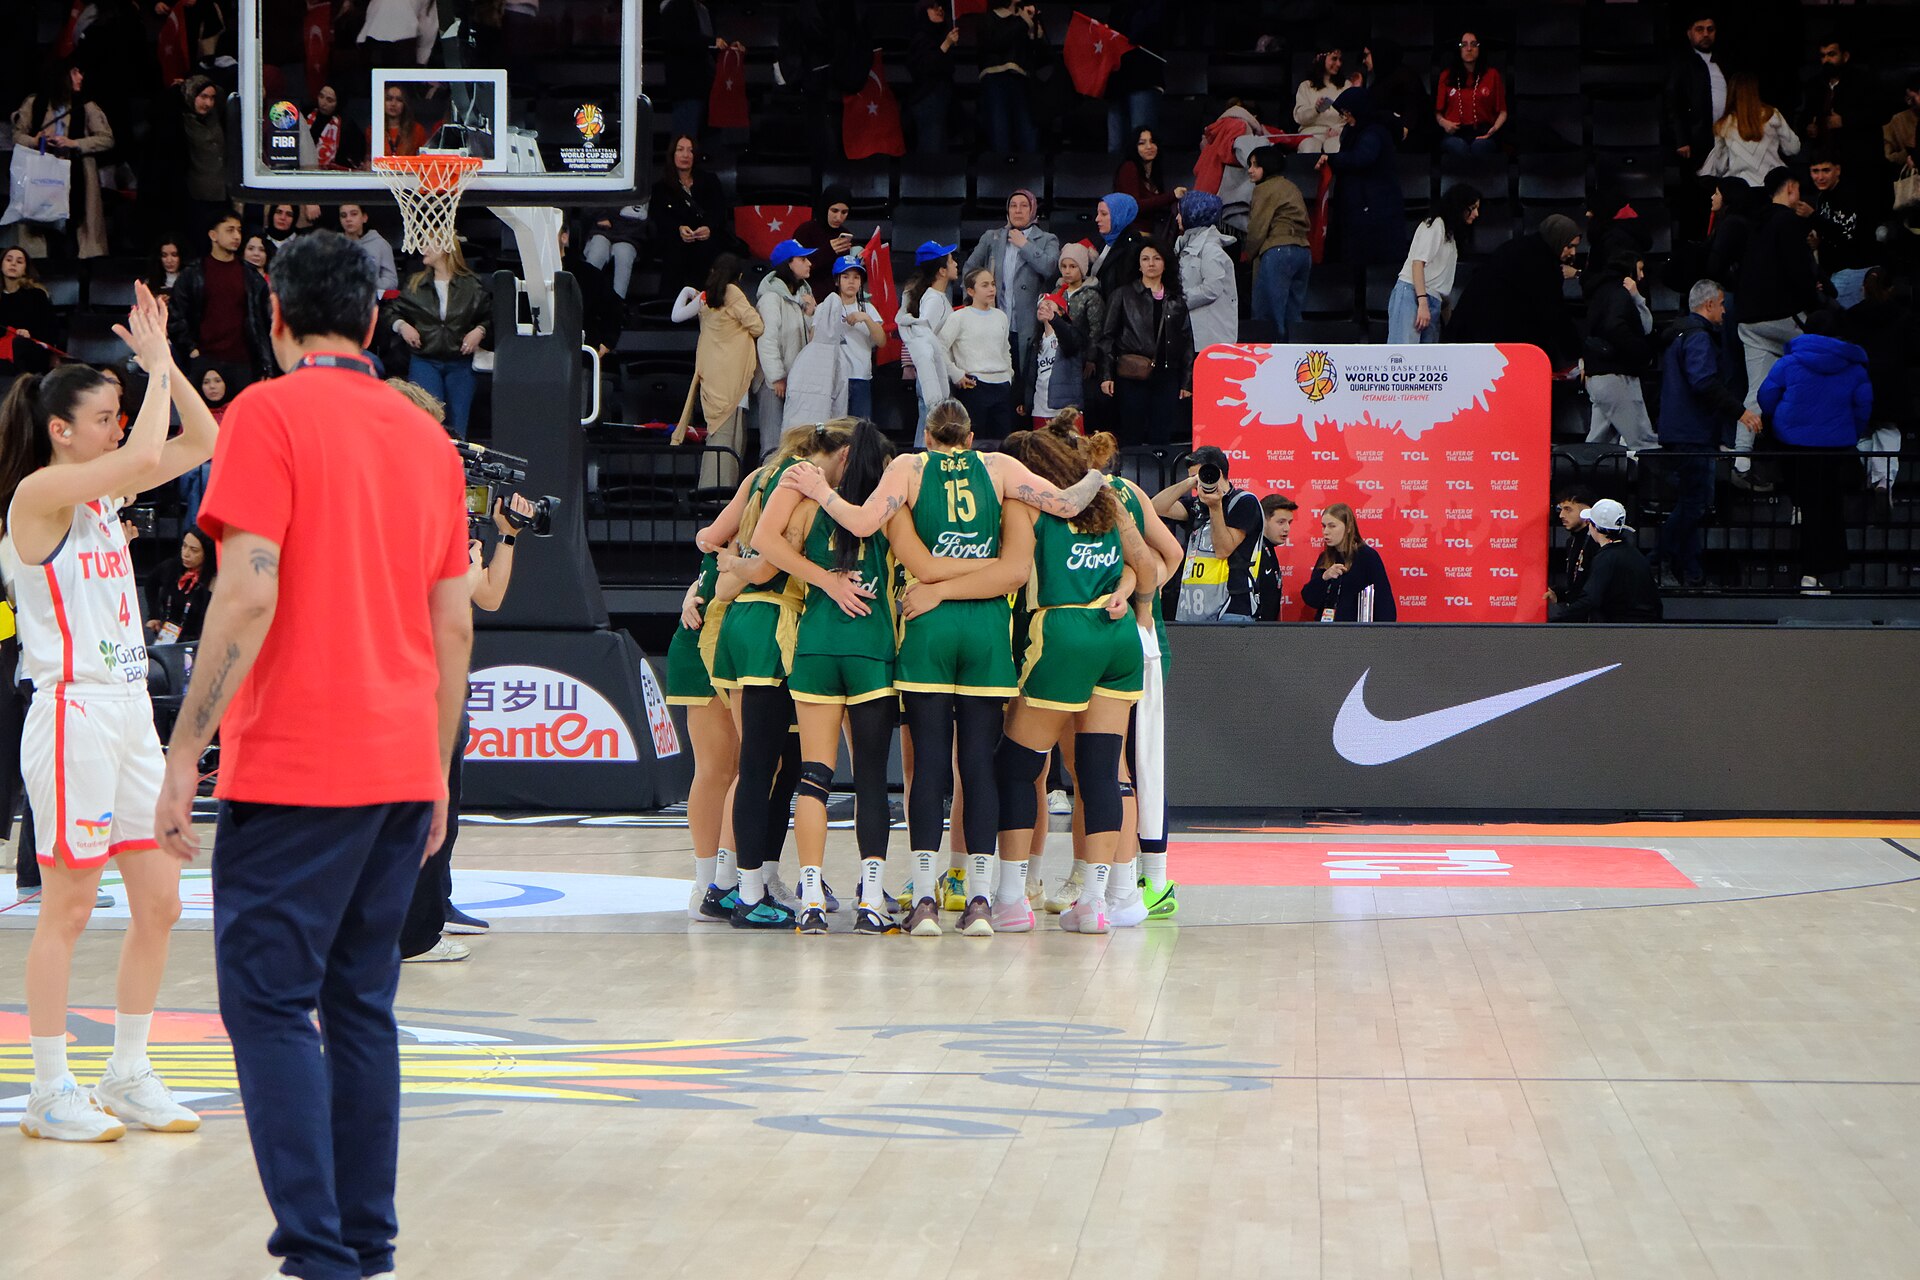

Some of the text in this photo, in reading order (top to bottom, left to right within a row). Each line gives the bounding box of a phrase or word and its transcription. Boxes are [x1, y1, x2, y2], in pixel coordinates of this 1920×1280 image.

[272, 136, 295, 148] FIBA
[1345, 373, 1448, 382] WORLD CUP 2026
[1350, 383, 1443, 391] QUALIFYING TOURNAMENTS
[1311, 451, 1339, 461] TCL
[1401, 451, 1429, 461] TCL
[1491, 451, 1519, 461] TCL
[1267, 479, 1295, 489] TCL
[1356, 480, 1384, 490] TCL
[1446, 480, 1474, 490] TCL
[943, 478, 977, 523] 15
[1400, 509, 1428, 519] TCL
[1490, 509, 1518, 519] TCL
[932, 531, 993, 559] Ford
[1363, 538, 1383, 547] CL
[1445, 538, 1473, 548] TCL
[1066, 542, 1121, 570] Ford
[1400, 567, 1428, 577] TCL
[1490, 567, 1518, 577] TCL
[1444, 596, 1472, 606] TCL
[118, 592, 131, 627] 4
[466, 680, 578, 713] 百岁山
[1321, 849, 1514, 880] TCL
